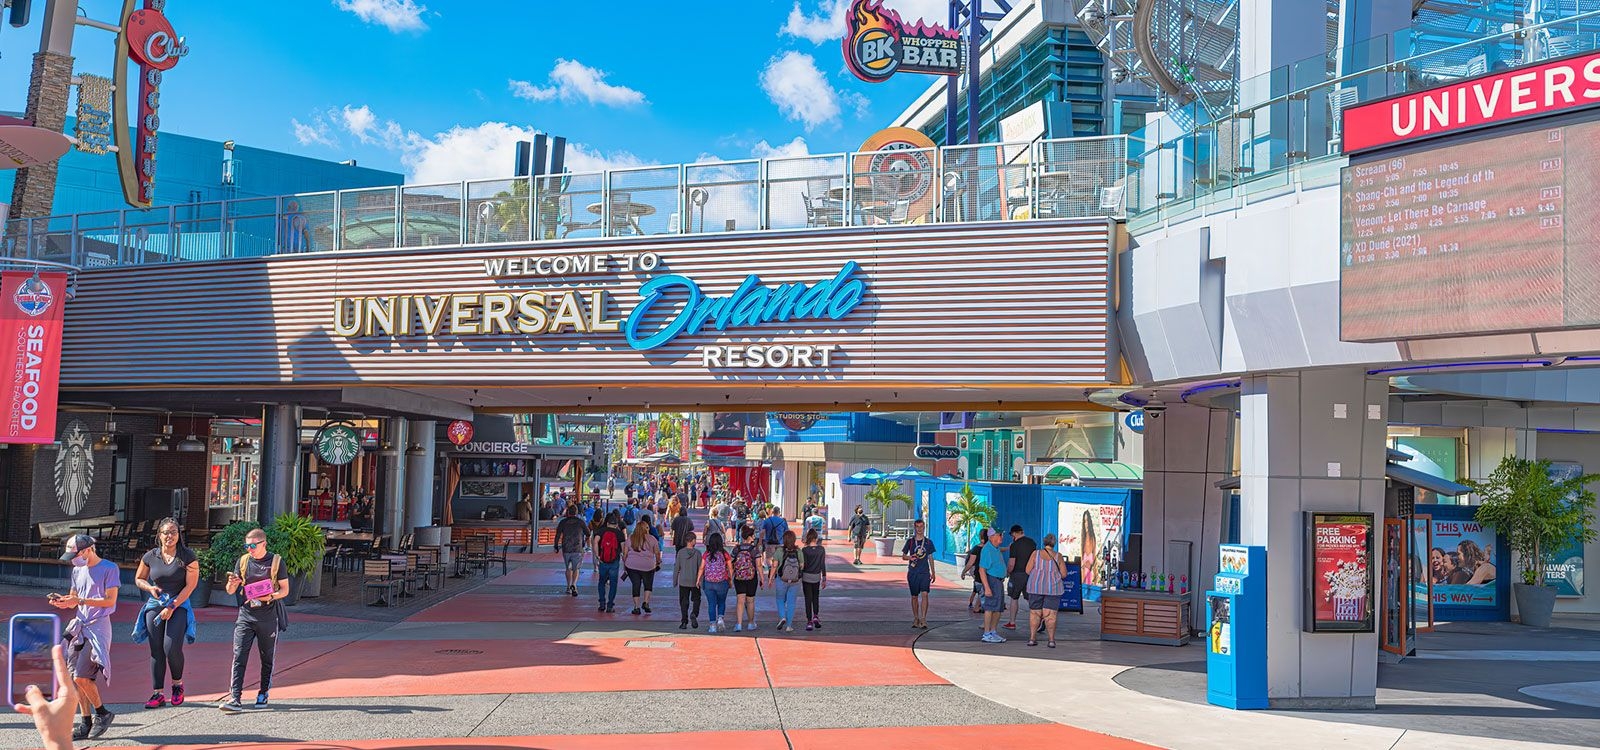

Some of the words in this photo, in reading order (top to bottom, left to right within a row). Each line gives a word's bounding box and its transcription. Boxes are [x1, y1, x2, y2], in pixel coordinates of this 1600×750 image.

[144, 31, 189, 63] Club
[863, 36, 895, 63] BK
[901, 37, 958, 49] WHOPPER
[902, 46, 958, 67] BAR
[1355, 163, 1386, 178] Scream
[1355, 185, 1398, 203] Shang-Chi
[1400, 182, 1416, 194] and
[1418, 180, 1432, 191] the
[1435, 173, 1469, 189] Legend
[1472, 170, 1482, 182] of
[1355, 214, 1387, 228] Venom:
[1388, 211, 1402, 223] Let
[1405, 208, 1429, 220] There
[1432, 204, 1444, 215] Be
[1446, 199, 1487, 214] Carnage
[1355, 242, 1367, 253] XD
[1369, 240, 1390, 251] Dune
[1393, 234, 1421, 250] (2021)
[484, 255, 609, 277] WELCOME
[623, 252, 659, 272] TO
[334, 290, 623, 337] UNIVERSAL
[625, 260, 867, 350] Orlando
[14, 331, 27, 382] SOUTHERN
[702, 344, 836, 368] RESORT
[20, 325, 44, 431] SEAFOOD
[9, 385, 22, 437] FAVORITES
[455, 441, 528, 453] CONCIERGE
[919, 448, 958, 456] CINNABON
[1317, 527, 1341, 536] FREE
[1435, 522, 1459, 532] THIS
[1462, 523, 1484, 533] WAY
[1317, 536, 1357, 544] PARKING
[1546, 571, 1566, 579] TERS
[1432, 593, 1447, 603] HIS
[1450, 593, 1473, 603] WAY
